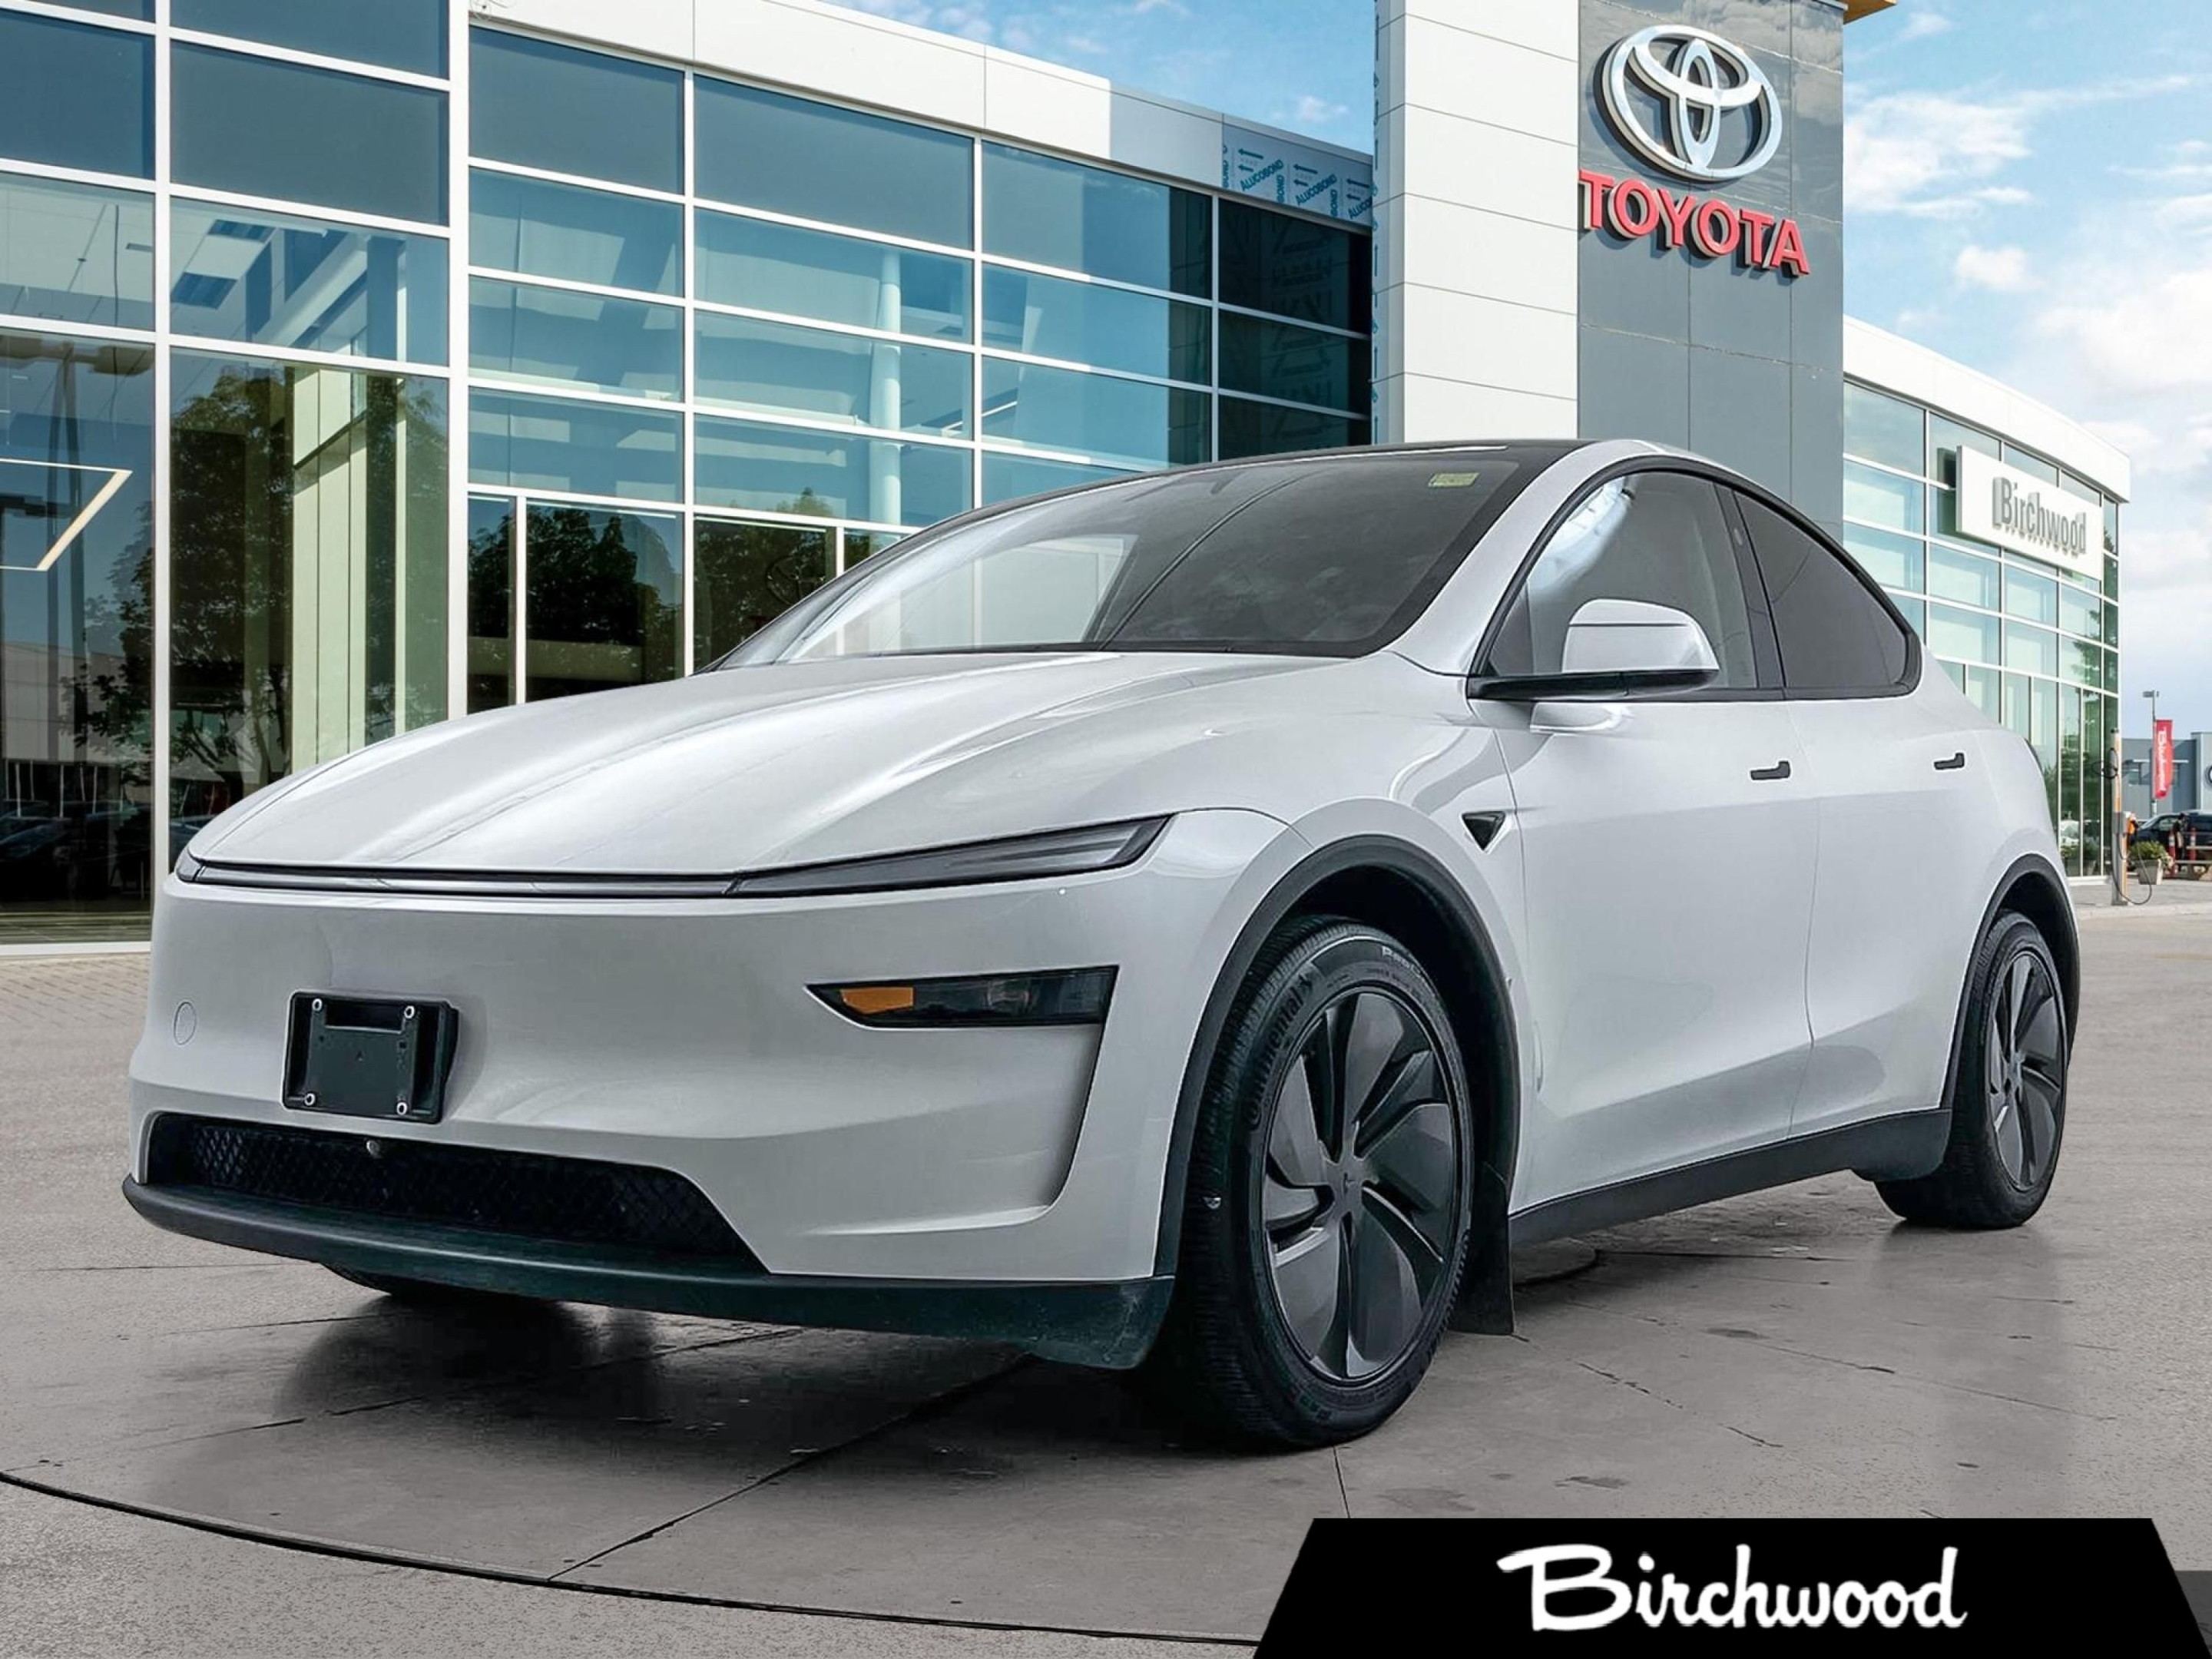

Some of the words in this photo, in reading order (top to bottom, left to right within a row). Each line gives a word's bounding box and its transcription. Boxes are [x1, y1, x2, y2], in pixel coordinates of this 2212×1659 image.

[1240, 158, 1284, 192] ALUCOBOND
[1578, 170, 1810, 276] TOYOTA
[1992, 476, 2087, 558] Birchwood
